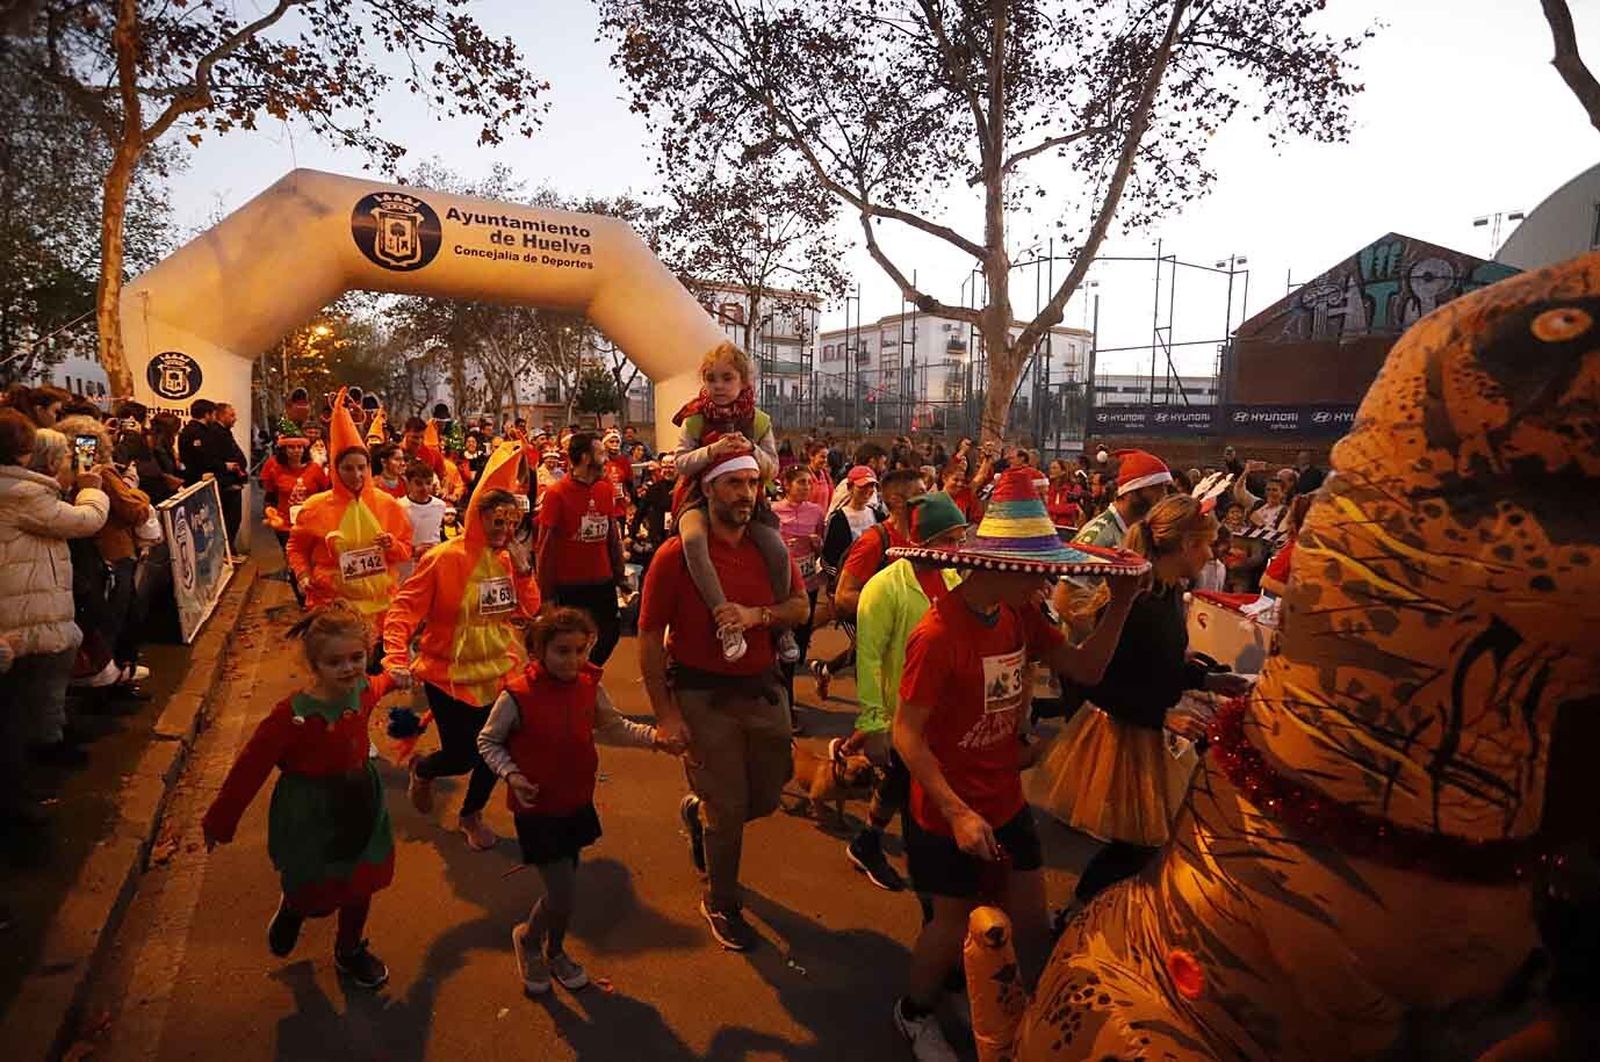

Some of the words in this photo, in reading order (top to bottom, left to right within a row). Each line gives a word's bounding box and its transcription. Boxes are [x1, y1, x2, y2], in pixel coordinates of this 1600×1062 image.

[446, 207, 591, 238] Ayuntamiento
[490, 230, 516, 246] de
[523, 233, 592, 256] Huelva
[523, 253, 539, 263] de
[541, 255, 594, 270] Deportes
[1110, 412, 1146, 422] HYUNDAI
[1170, 412, 1211, 422] HYUNDAI
[1250, 411, 1299, 423] HYUNDAI
[360, 555, 383, 569] 142
